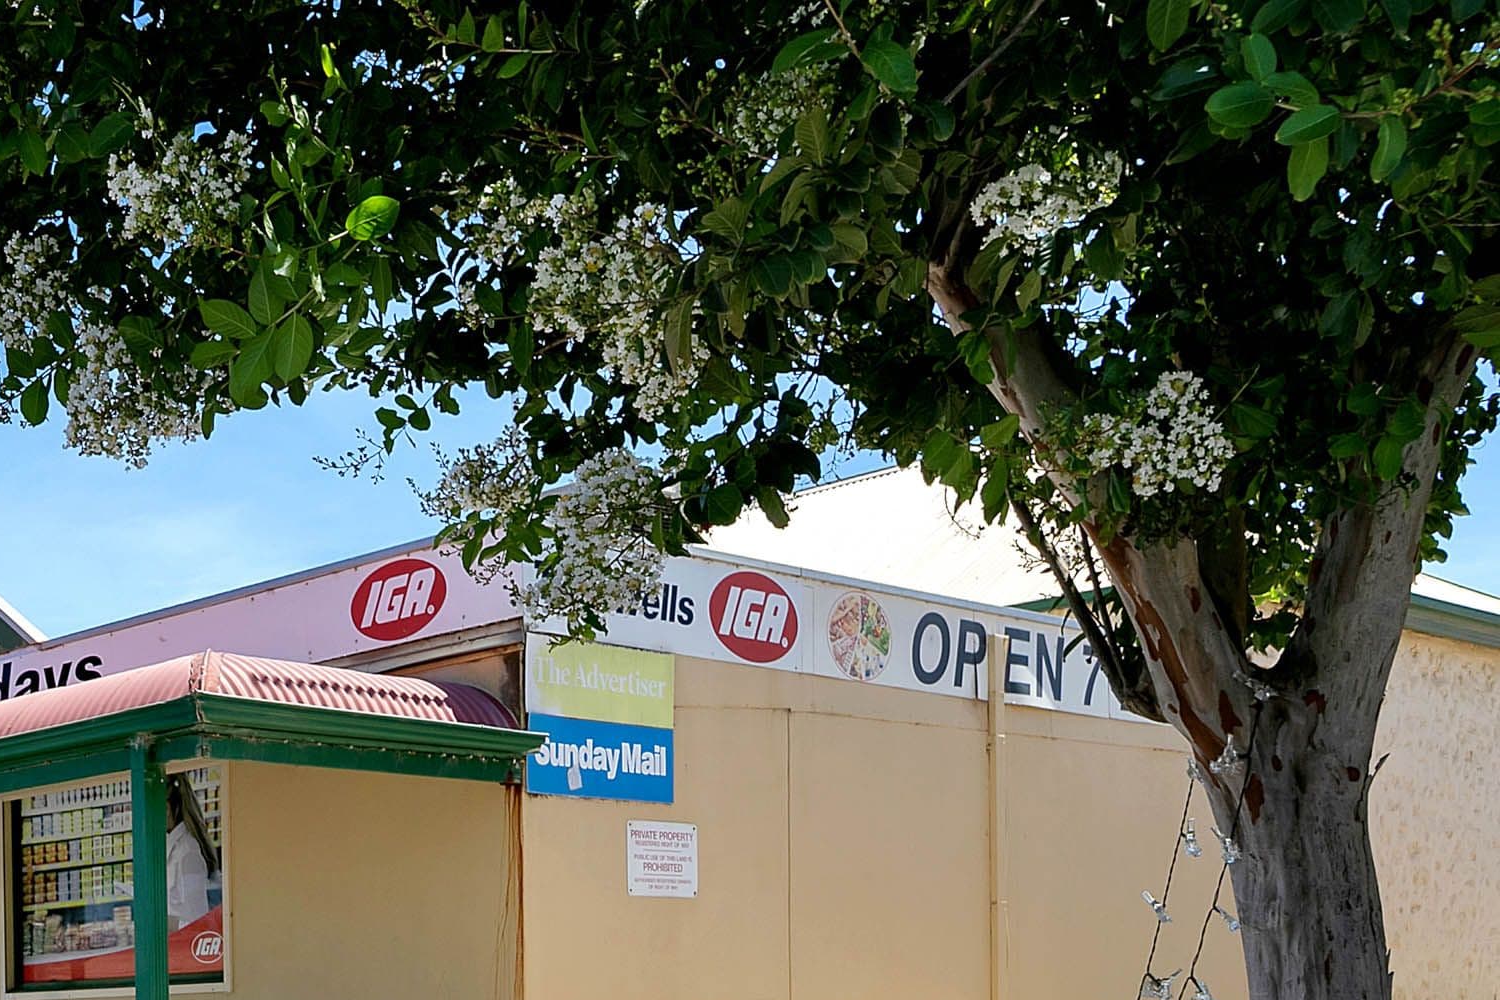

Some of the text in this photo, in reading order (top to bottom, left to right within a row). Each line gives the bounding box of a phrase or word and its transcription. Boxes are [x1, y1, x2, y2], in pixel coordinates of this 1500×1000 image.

[360, 567, 436, 630] IGA
[613, 580, 695, 626] ells
[718, 585, 790, 648] IGA
[534, 655, 667, 699] The Advertiser
[911, 611, 1066, 702] OPEN
[534, 737, 667, 780] Sunday Mail
[630, 829, 693, 842] PRIVATE PROPERTY
[643, 861, 683, 873] PROHIBITED
[195, 937, 221, 957] IGA
